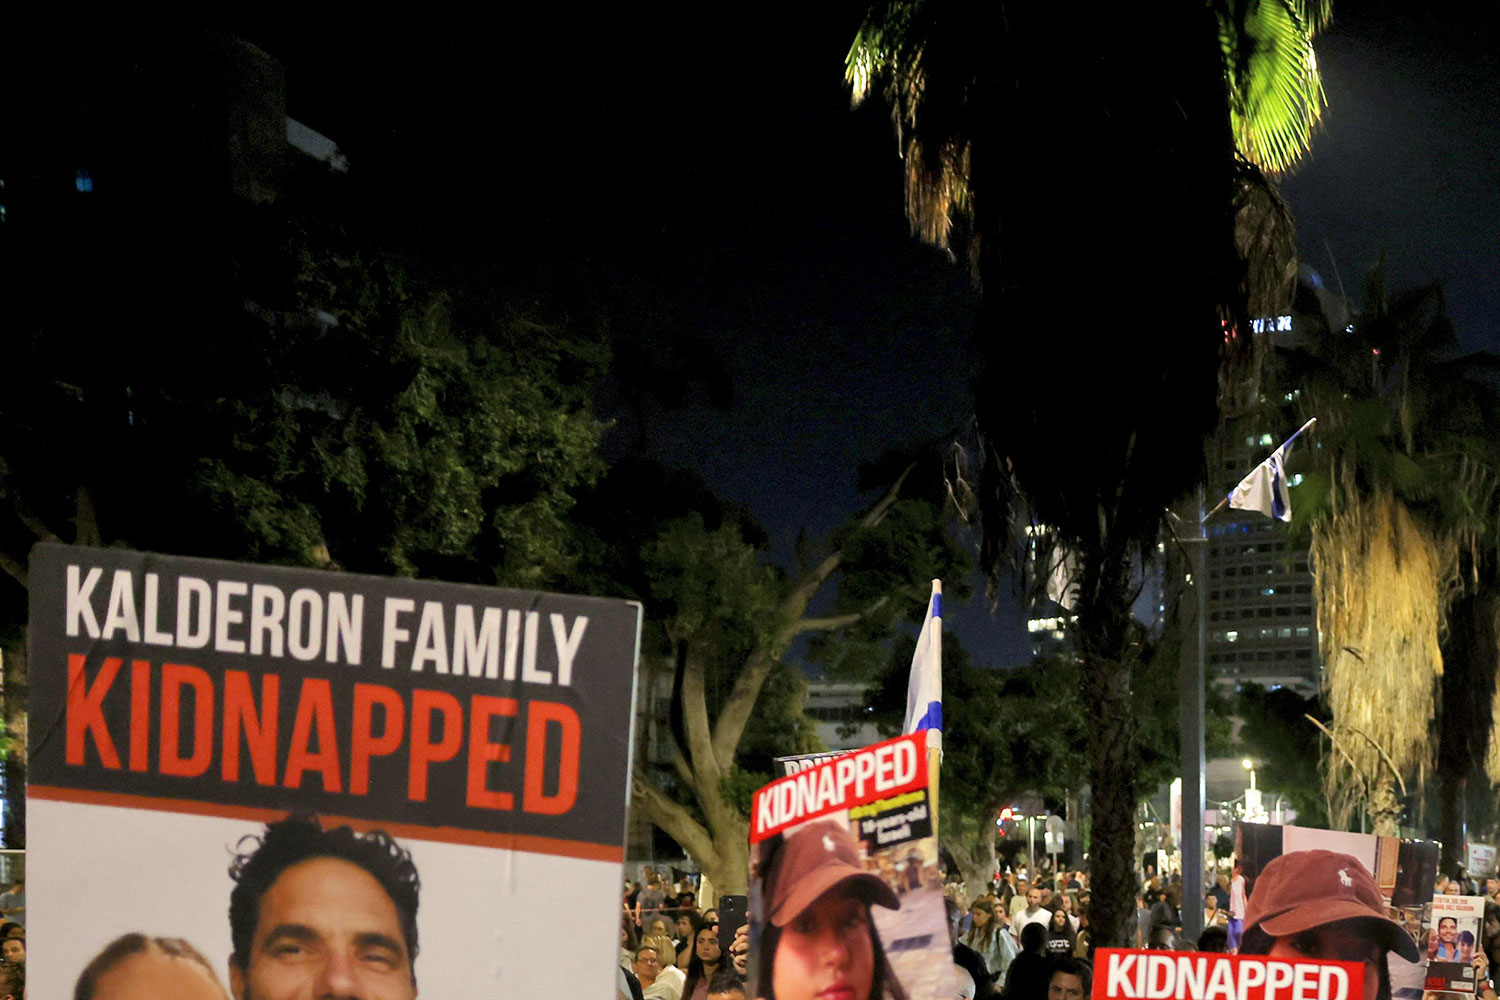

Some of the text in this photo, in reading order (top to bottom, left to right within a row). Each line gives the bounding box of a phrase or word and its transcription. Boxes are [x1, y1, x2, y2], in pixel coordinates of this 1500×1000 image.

[65, 565, 589, 686] KALDERON FAMILY
[64, 653, 582, 816] KIDNAPPED
[757, 739, 917, 833] KIDNAPPED
